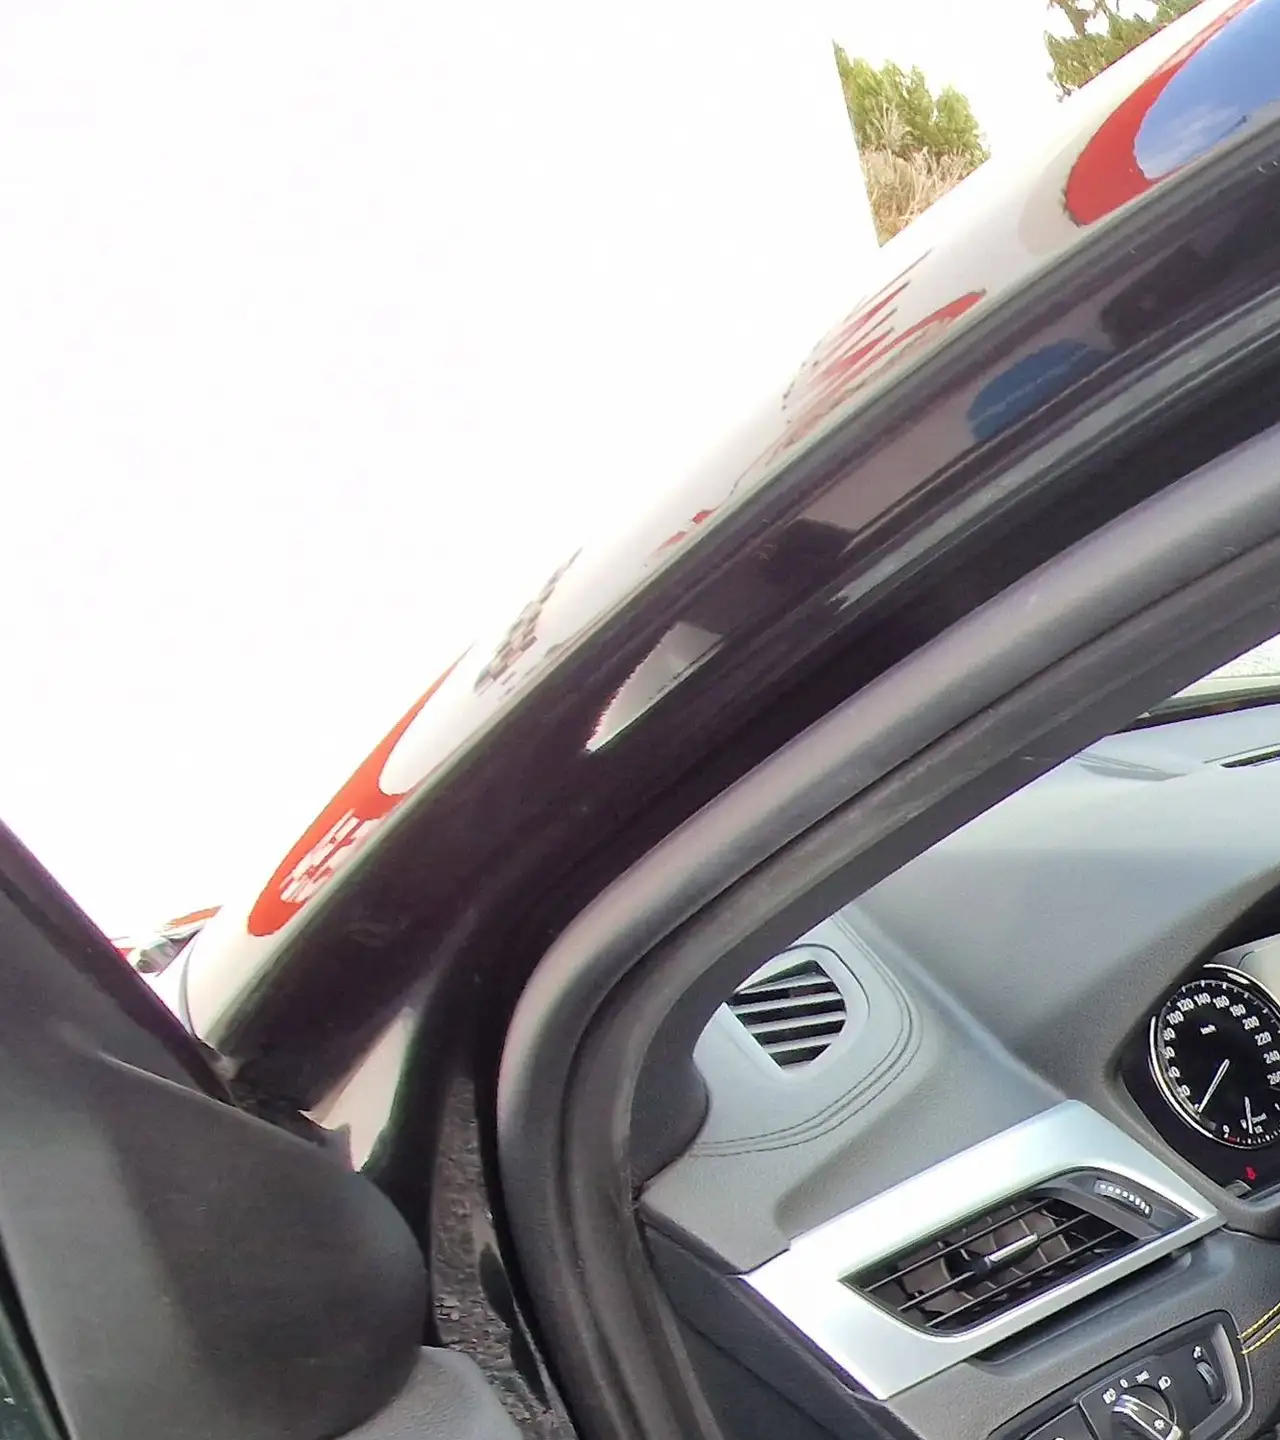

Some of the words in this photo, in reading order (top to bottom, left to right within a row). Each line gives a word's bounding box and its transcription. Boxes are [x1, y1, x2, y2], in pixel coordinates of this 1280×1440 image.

[1177, 998, 1194, 1012] 120
[1194, 993, 1211, 1006] 140
[1166, 1011, 1184, 1025] 100
[1242, 1016, 1260, 1030] 200
[1255, 1031, 1272, 1046] 220
[1263, 1050, 1280, 1064] 240
